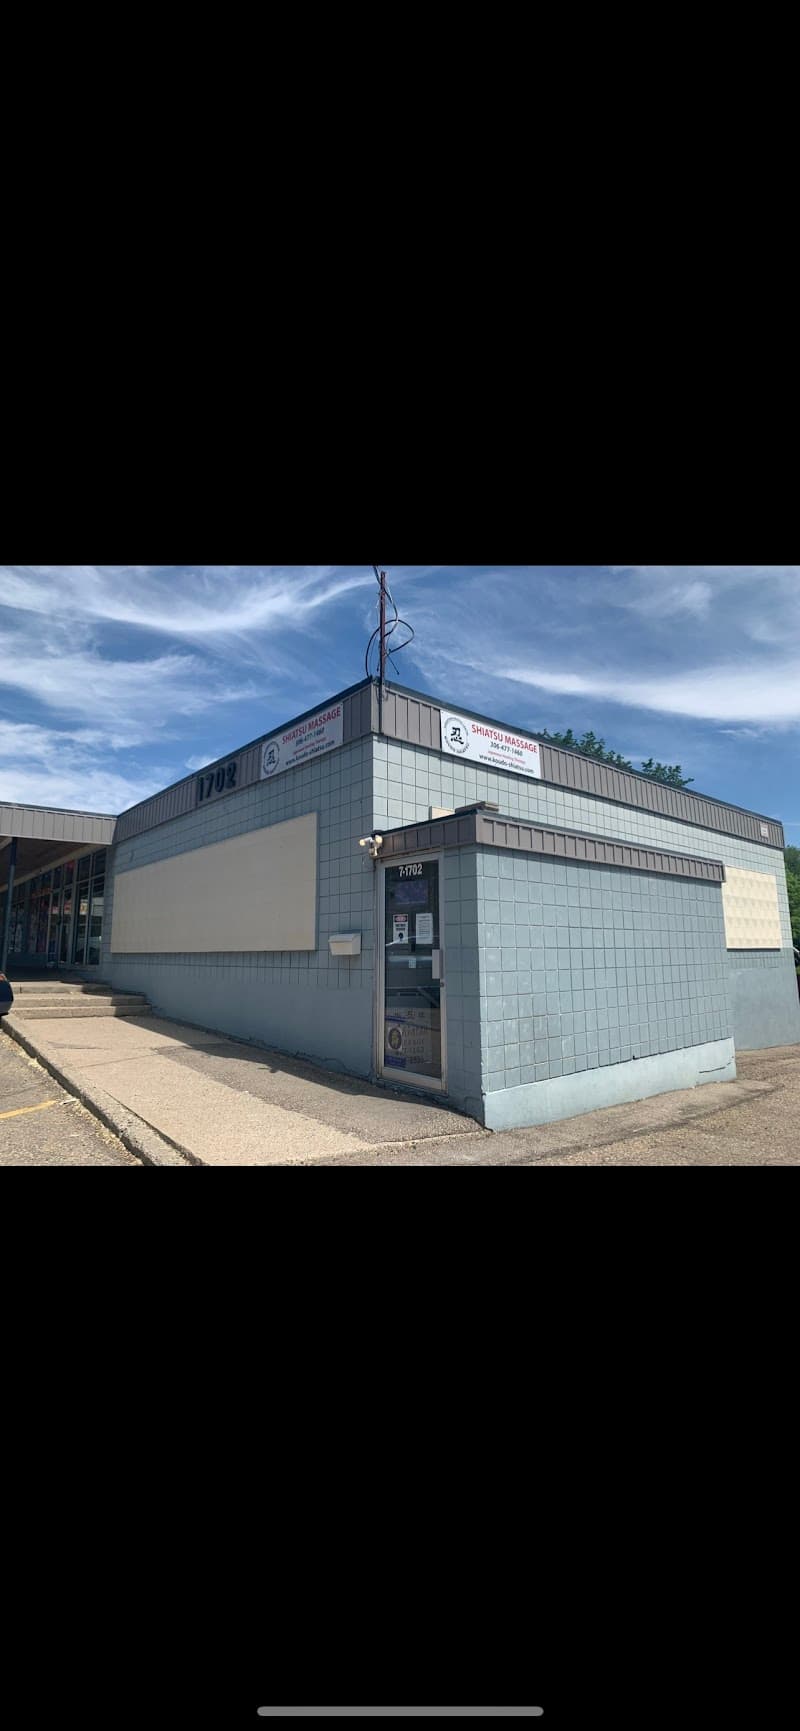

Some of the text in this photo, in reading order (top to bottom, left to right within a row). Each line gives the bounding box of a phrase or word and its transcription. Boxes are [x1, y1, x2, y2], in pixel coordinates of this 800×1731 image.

[282, 707, 341, 745] SHIATSU MASSAGE
[471, 724, 503, 742] SHIATSU
[504, 735, 538, 753] MASSAGE
[196, 761, 237, 801] 1702
[399, 863, 423, 878] 7-1702
